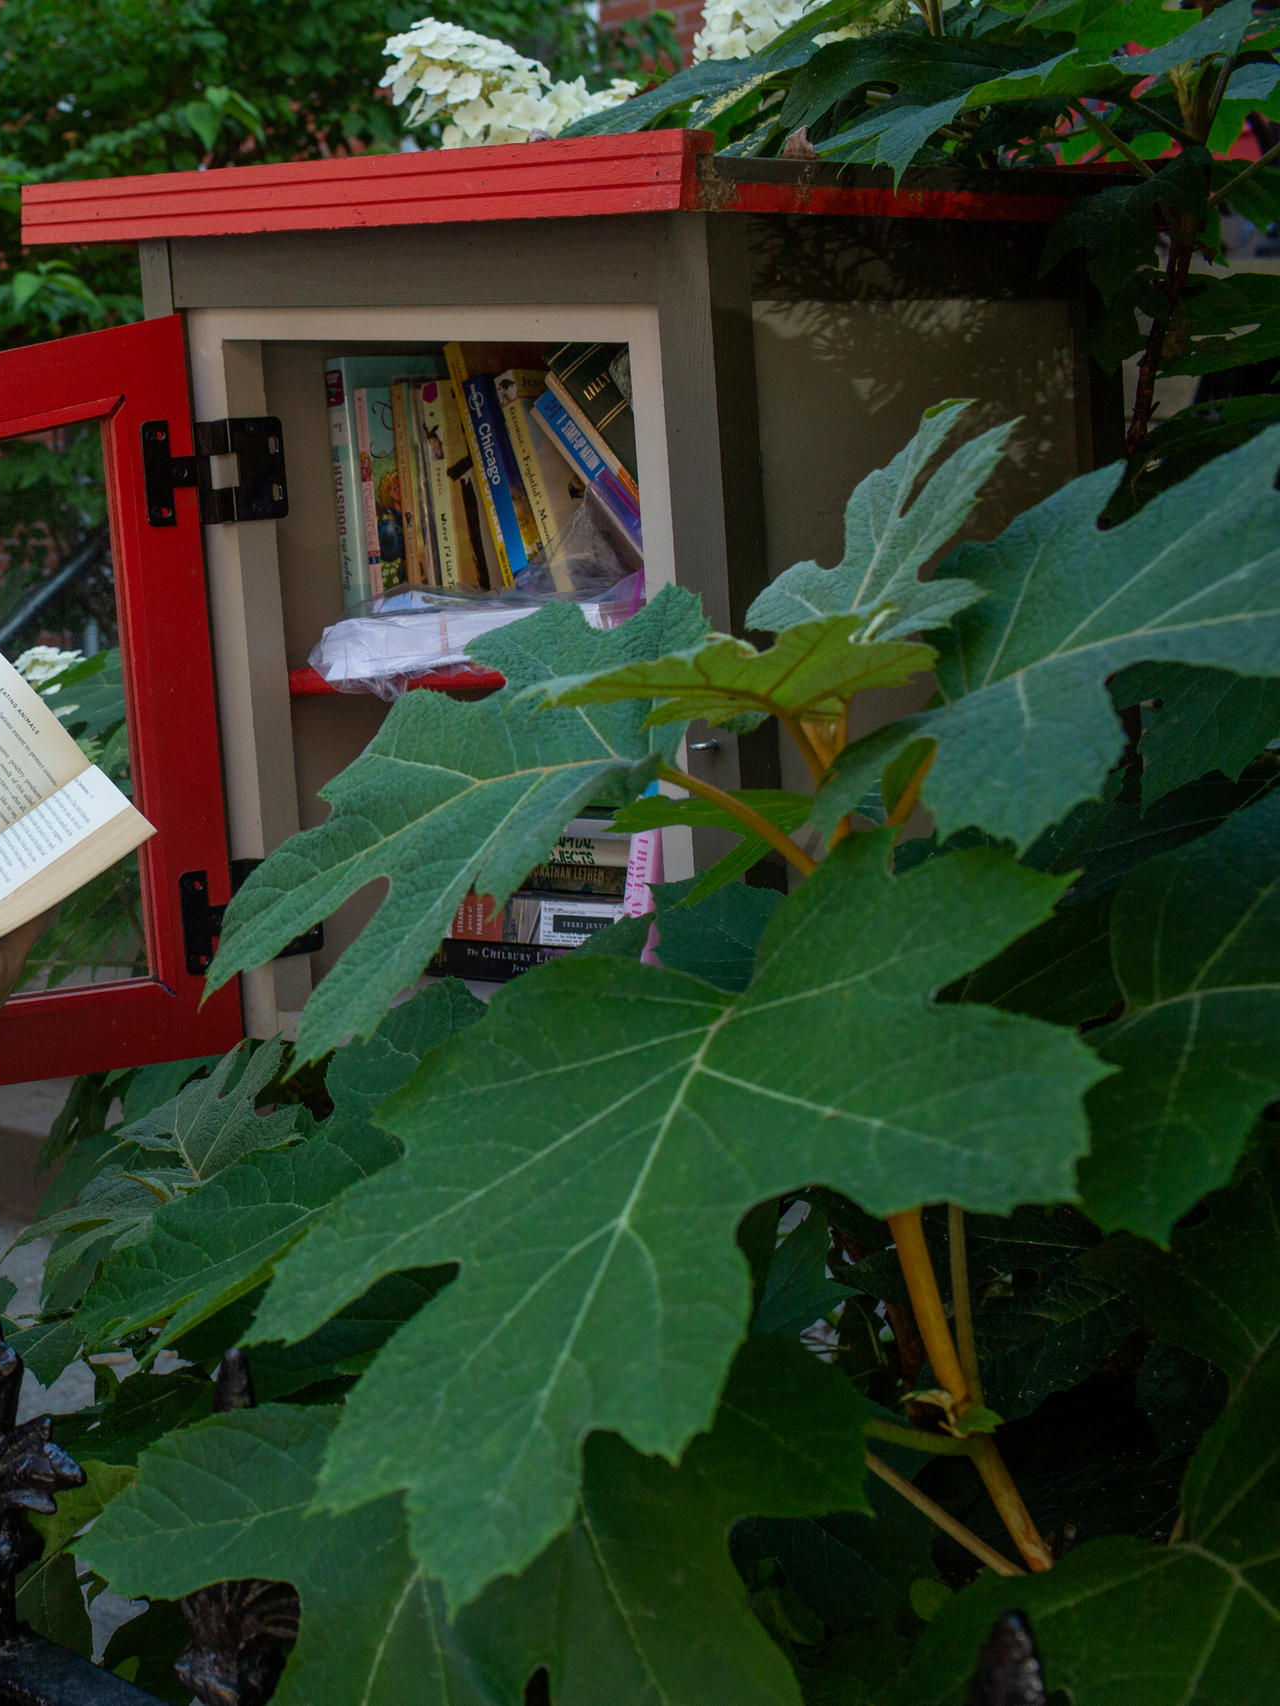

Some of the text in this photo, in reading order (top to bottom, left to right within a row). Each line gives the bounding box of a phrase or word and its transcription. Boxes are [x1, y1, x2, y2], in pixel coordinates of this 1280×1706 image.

[581, 370, 612, 401] LILLY
[508, 406, 525, 445] GEORGE
[476, 422, 503, 485] Chicago
[333, 464, 346, 535] DOGSTAR
[470, 434, 487, 482] LABOR
[483, 484, 493, 502] OF
[488, 502, 504, 543] CARE
[439, 512, 449, 540] Where
[443, 545, 452, 557] I'd
[444, 559, 453, 577] Like
[573, 867, 605, 882] LETHEM
[630, 850, 650, 892] HAVE
[472, 902, 486, 935] PARADISE
[562, 920, 584, 930] TERRI
